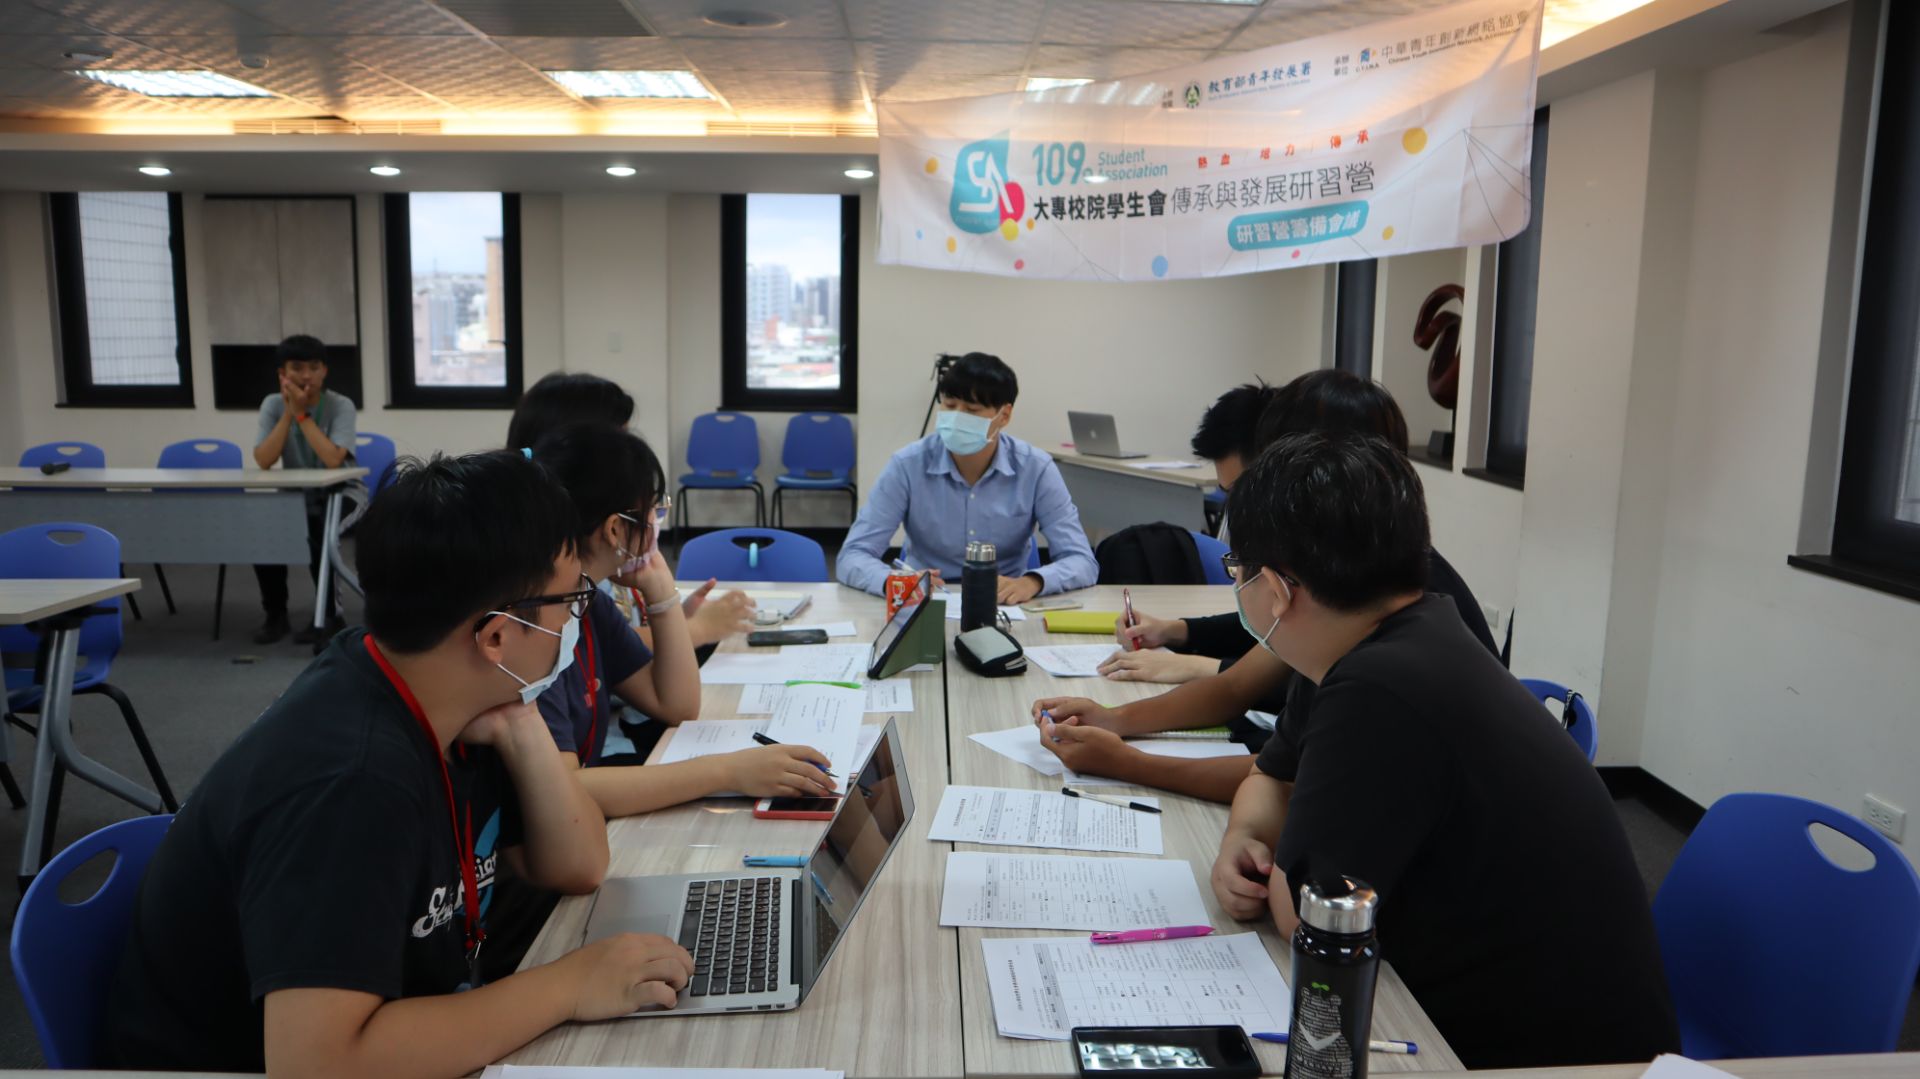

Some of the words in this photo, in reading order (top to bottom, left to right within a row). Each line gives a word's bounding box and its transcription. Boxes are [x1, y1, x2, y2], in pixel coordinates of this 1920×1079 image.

[1208, 61, 1311, 93] 教育部青年發展署
[1098, 148, 1145, 166] Student
[1034, 188, 1167, 221] 大專校院學生會
[1172, 160, 1375, 215] 傳承與發展研習營
[1236, 209, 1361, 244] 研習營籌備會議
